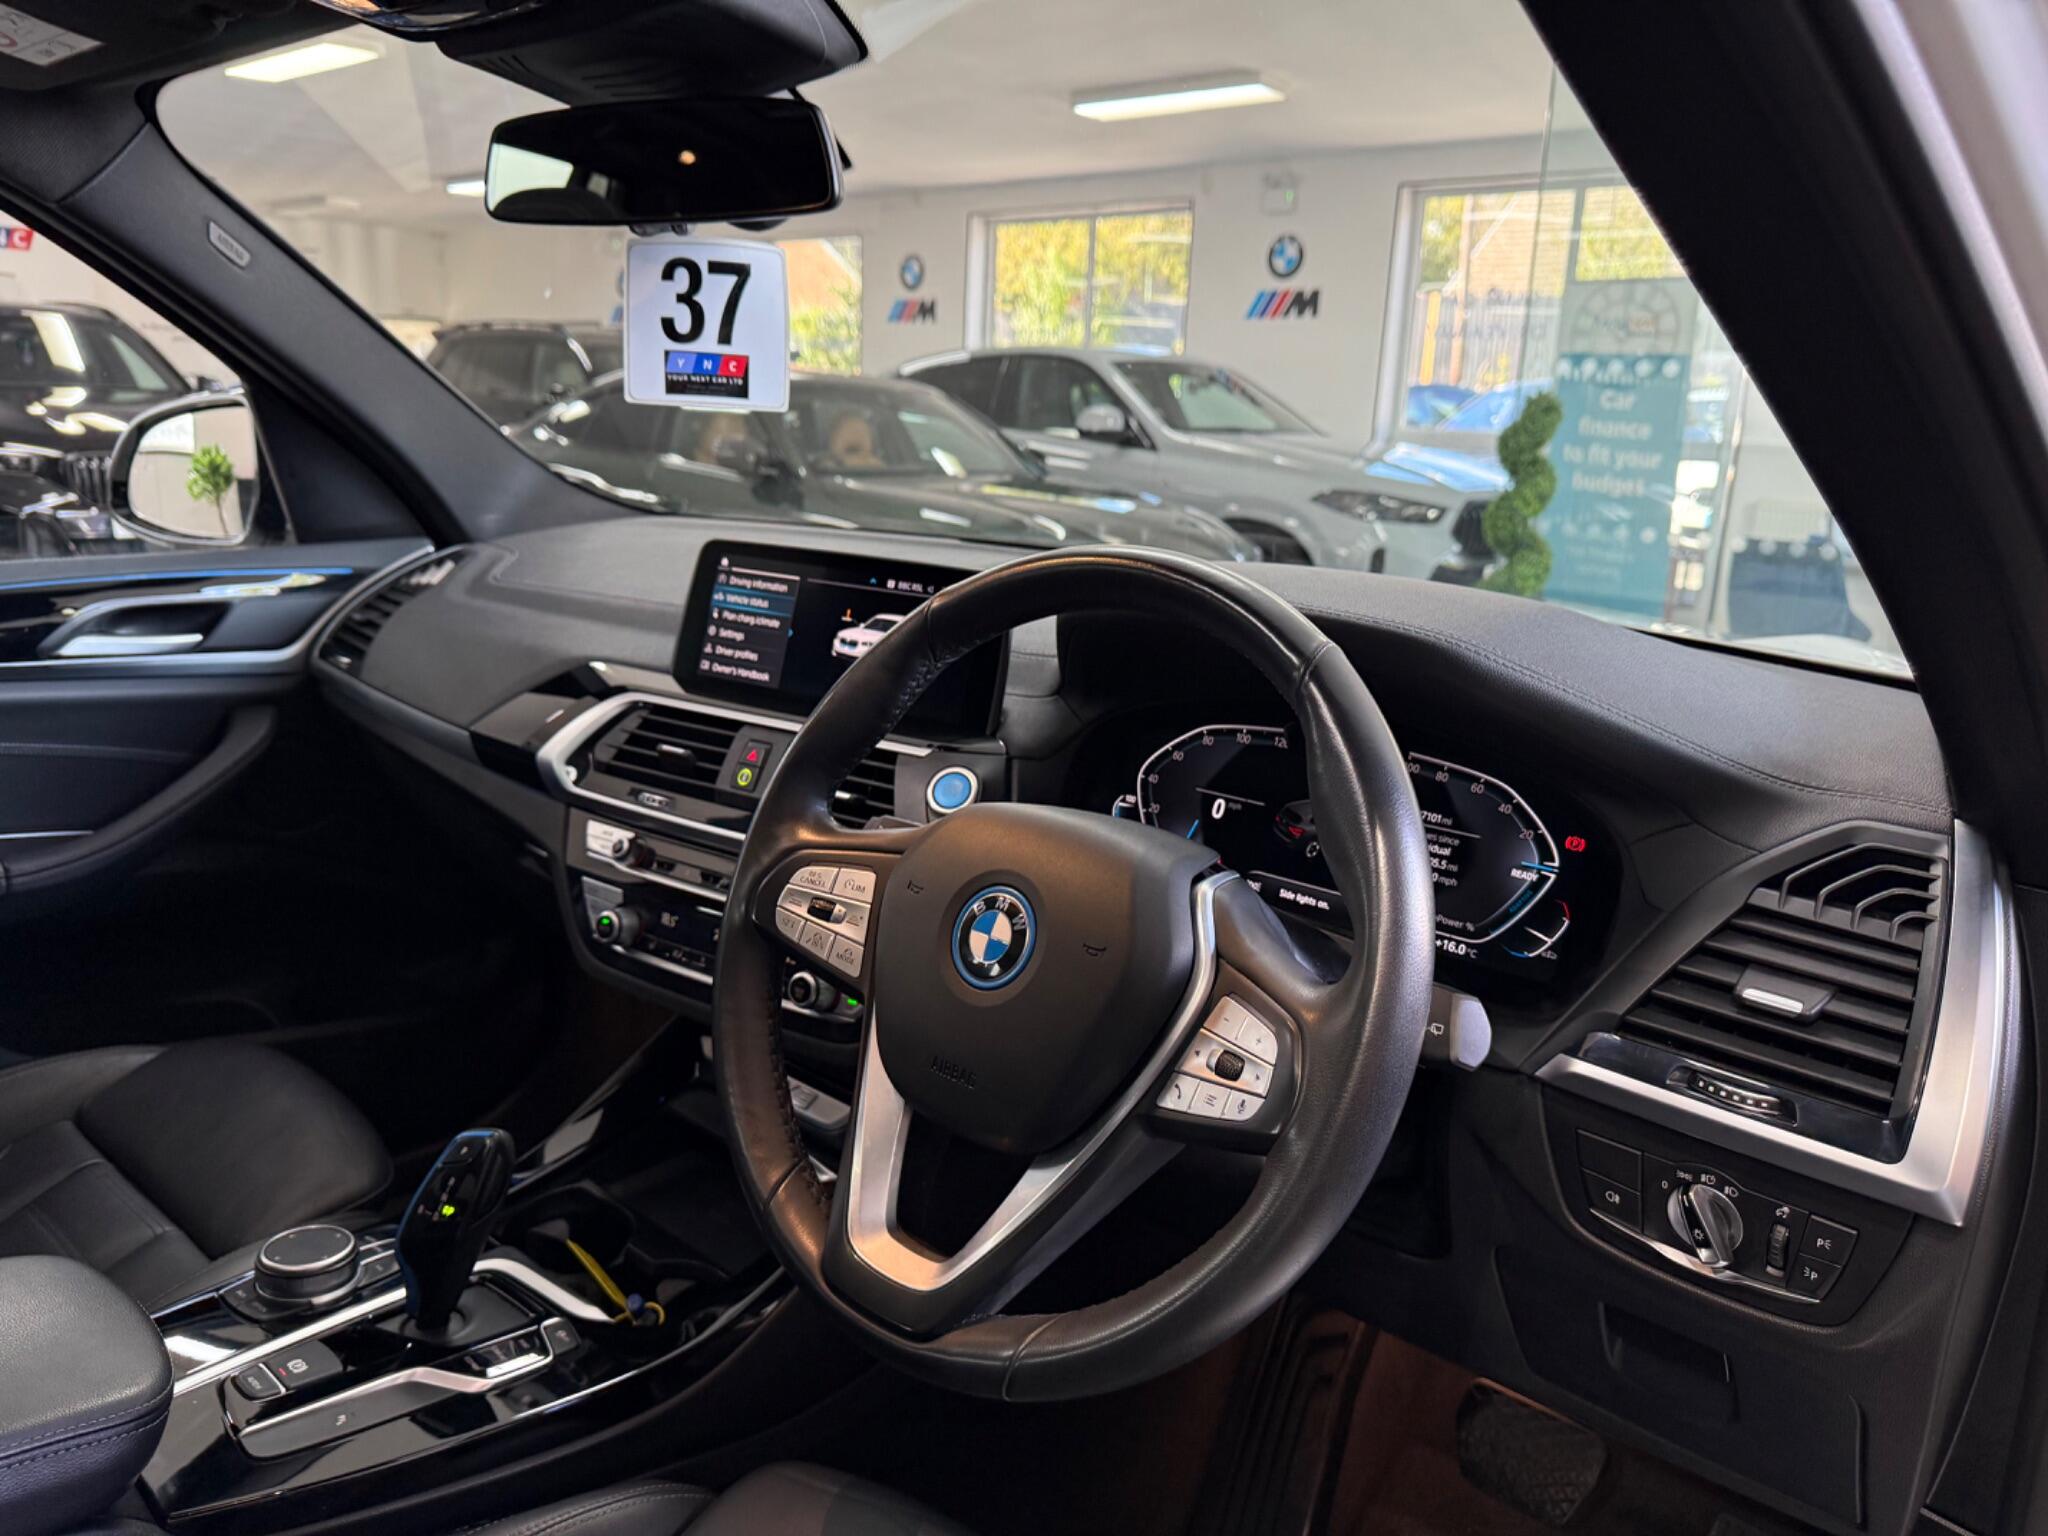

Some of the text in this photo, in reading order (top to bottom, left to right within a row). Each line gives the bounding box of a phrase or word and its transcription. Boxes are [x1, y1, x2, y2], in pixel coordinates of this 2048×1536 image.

[661, 257, 751, 346] 37
[1600, 389, 1635, 410] Car
[1578, 416, 1652, 440] finance
[1563, 443, 1662, 470] to fit your
[1572, 470, 1646, 497] budget
[729, 575, 788, 592] Driving information
[726, 594, 769, 608] Vehicle status
[722, 610, 738, 620] Plan
[719, 628, 745, 641] Settings
[715, 645, 758, 661] Driver profiles
[711, 662, 770, 681] Owner's Handbook
[1202, 735, 1214, 746] 80
[1237, 734, 1251, 744] 100
[1172, 751, 1184, 761] 60
[1148, 774, 1159, 784] 40
[1435, 772, 1449, 783] 80
[1471, 783, 1485, 794] 60
[1149, 803, 1160, 813] 20
[1211, 798, 1226, 820] 0
[1498, 804, 1513, 814] 40
[1438, 835, 1461, 847] since
[1520, 830, 1534, 840] 20
[1511, 868, 1540, 882] READY
[1439, 877, 1458, 887] mph
[1279, 888, 1296, 901] Side
[1296, 893, 1317, 906] lights
[973, 896, 1028, 931] BMW
